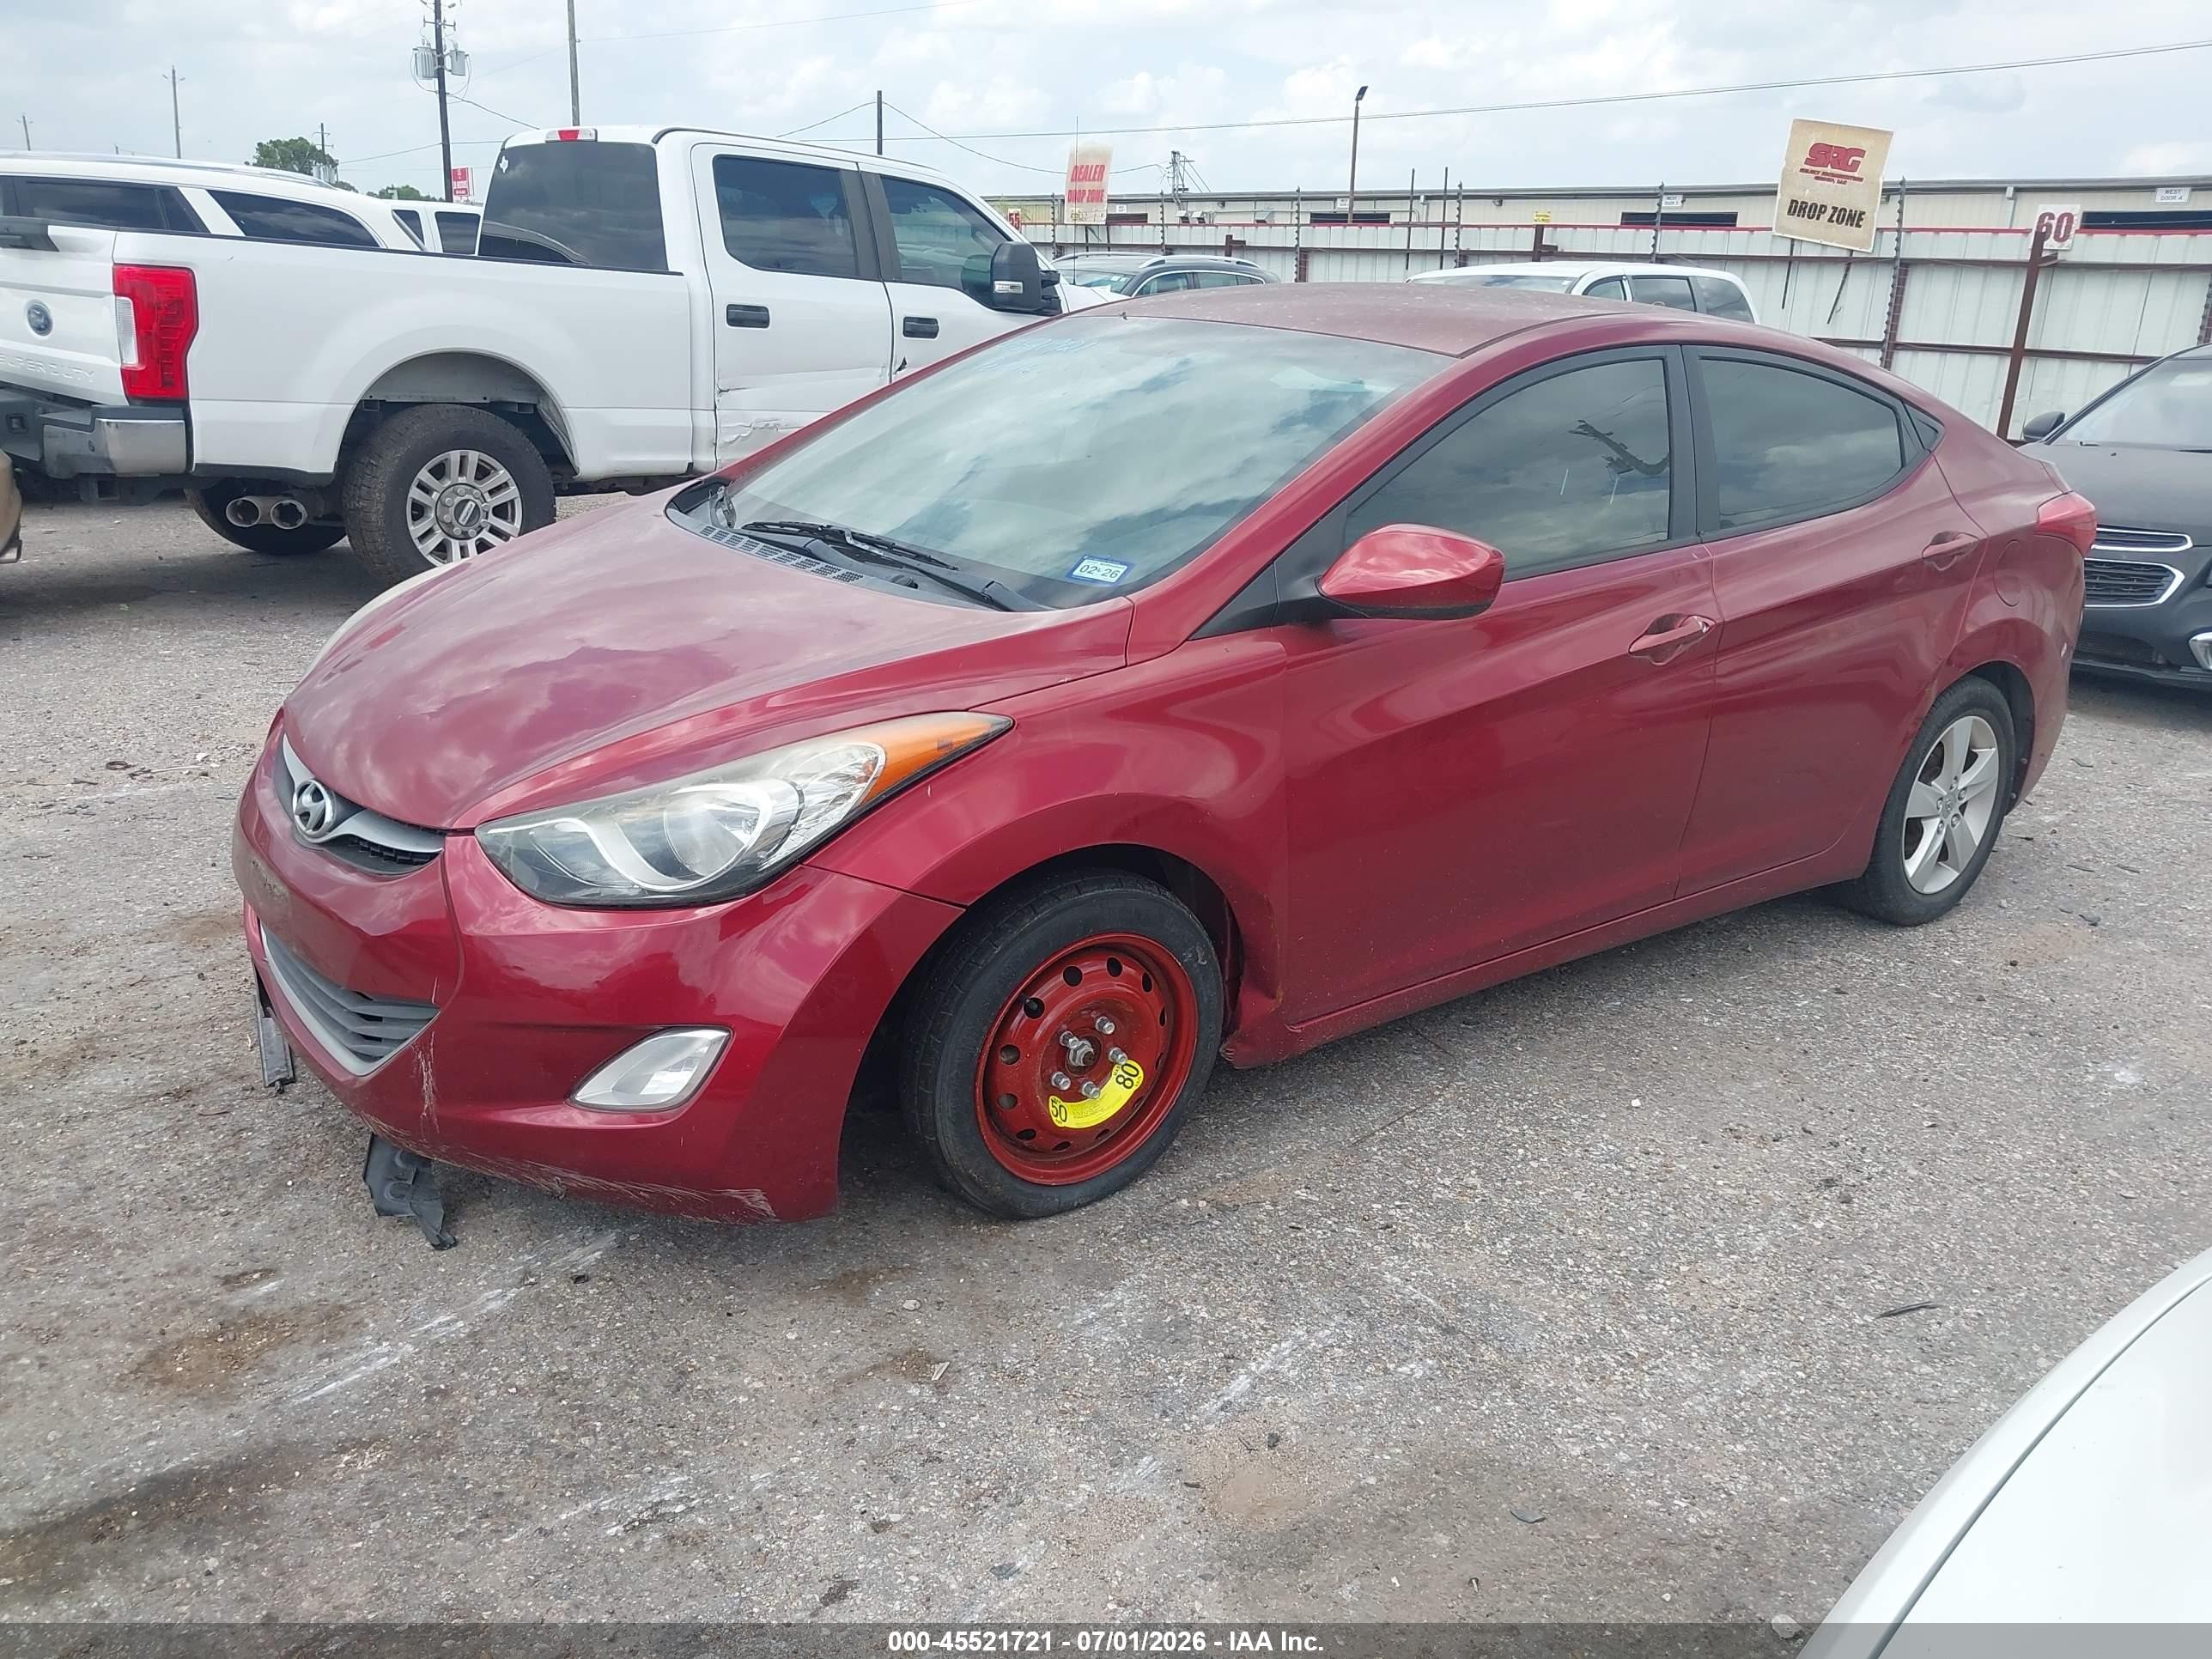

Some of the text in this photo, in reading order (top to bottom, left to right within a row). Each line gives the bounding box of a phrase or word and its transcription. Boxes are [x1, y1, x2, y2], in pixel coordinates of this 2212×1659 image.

[1804, 143, 1866, 173] SRG
[1070, 164, 1105, 182] DEALER
[1067, 189, 1104, 203] DROP ZONE
[1008, 212, 1020, 229] 55
[1787, 199, 1866, 228] DROP ZONE
[2034, 212, 2075, 244] 60
[1079, 564, 1097, 574] 02
[1100, 568, 1121, 579] 26
[1115, 1063, 1139, 1090] 80
[1050, 1098, 1067, 1123] 50
